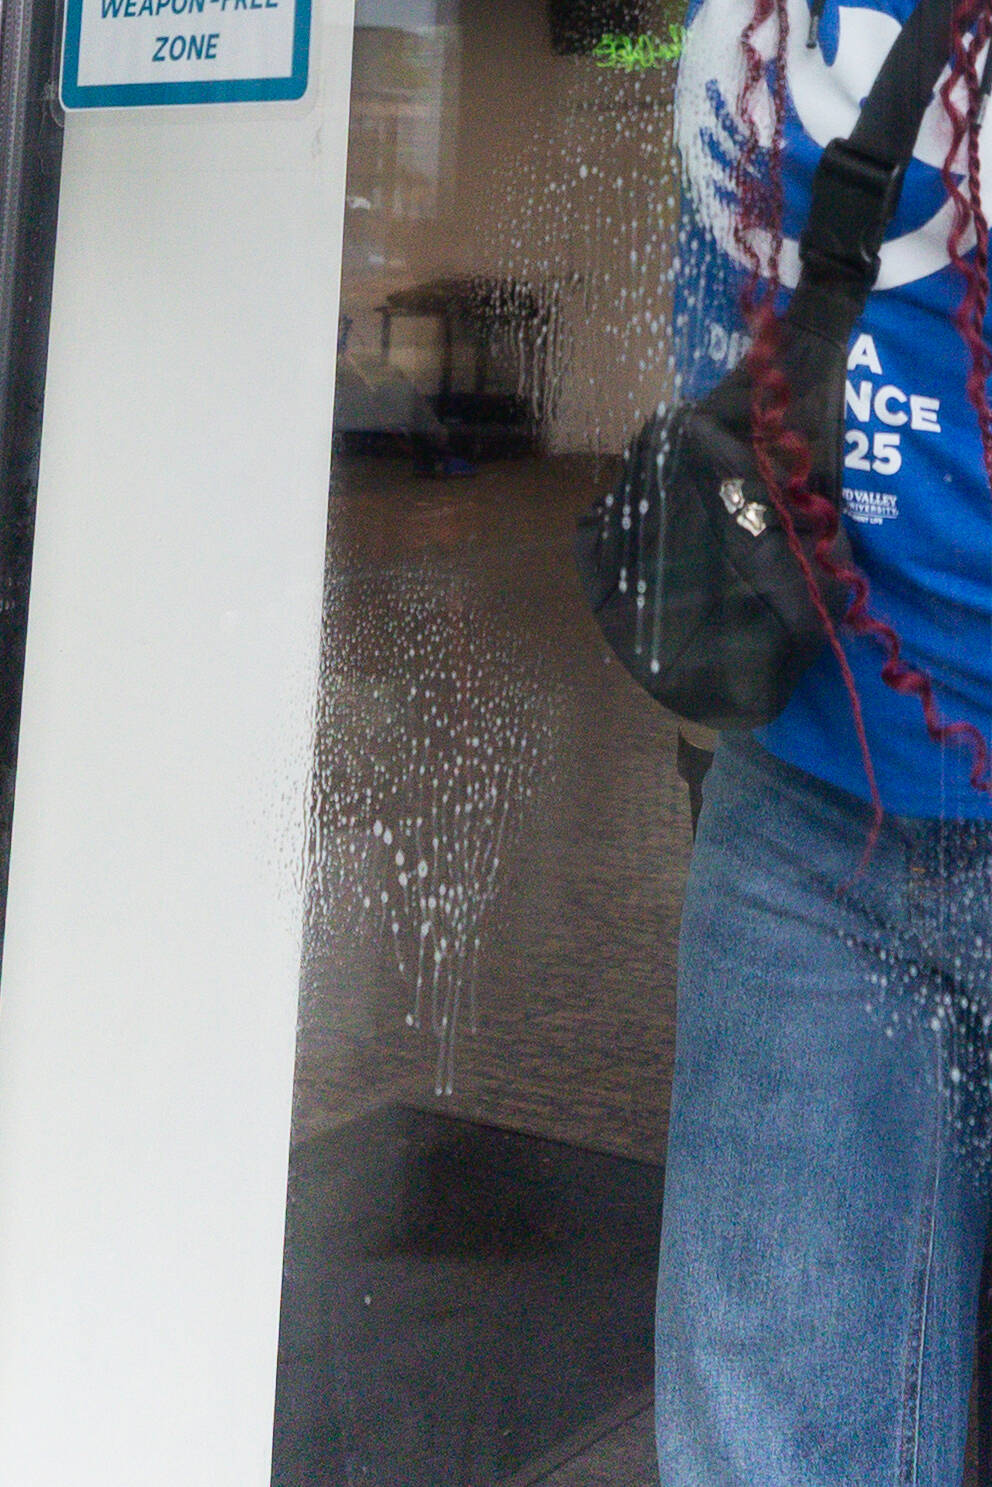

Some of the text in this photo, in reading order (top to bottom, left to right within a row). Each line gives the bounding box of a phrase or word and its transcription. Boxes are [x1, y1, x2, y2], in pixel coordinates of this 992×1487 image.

[151, 32, 220, 62] ZONE
[846, 332, 883, 375] A
[848, 500, 899, 516] NIVERSITY
[854, 488, 898, 509] VALLEY
